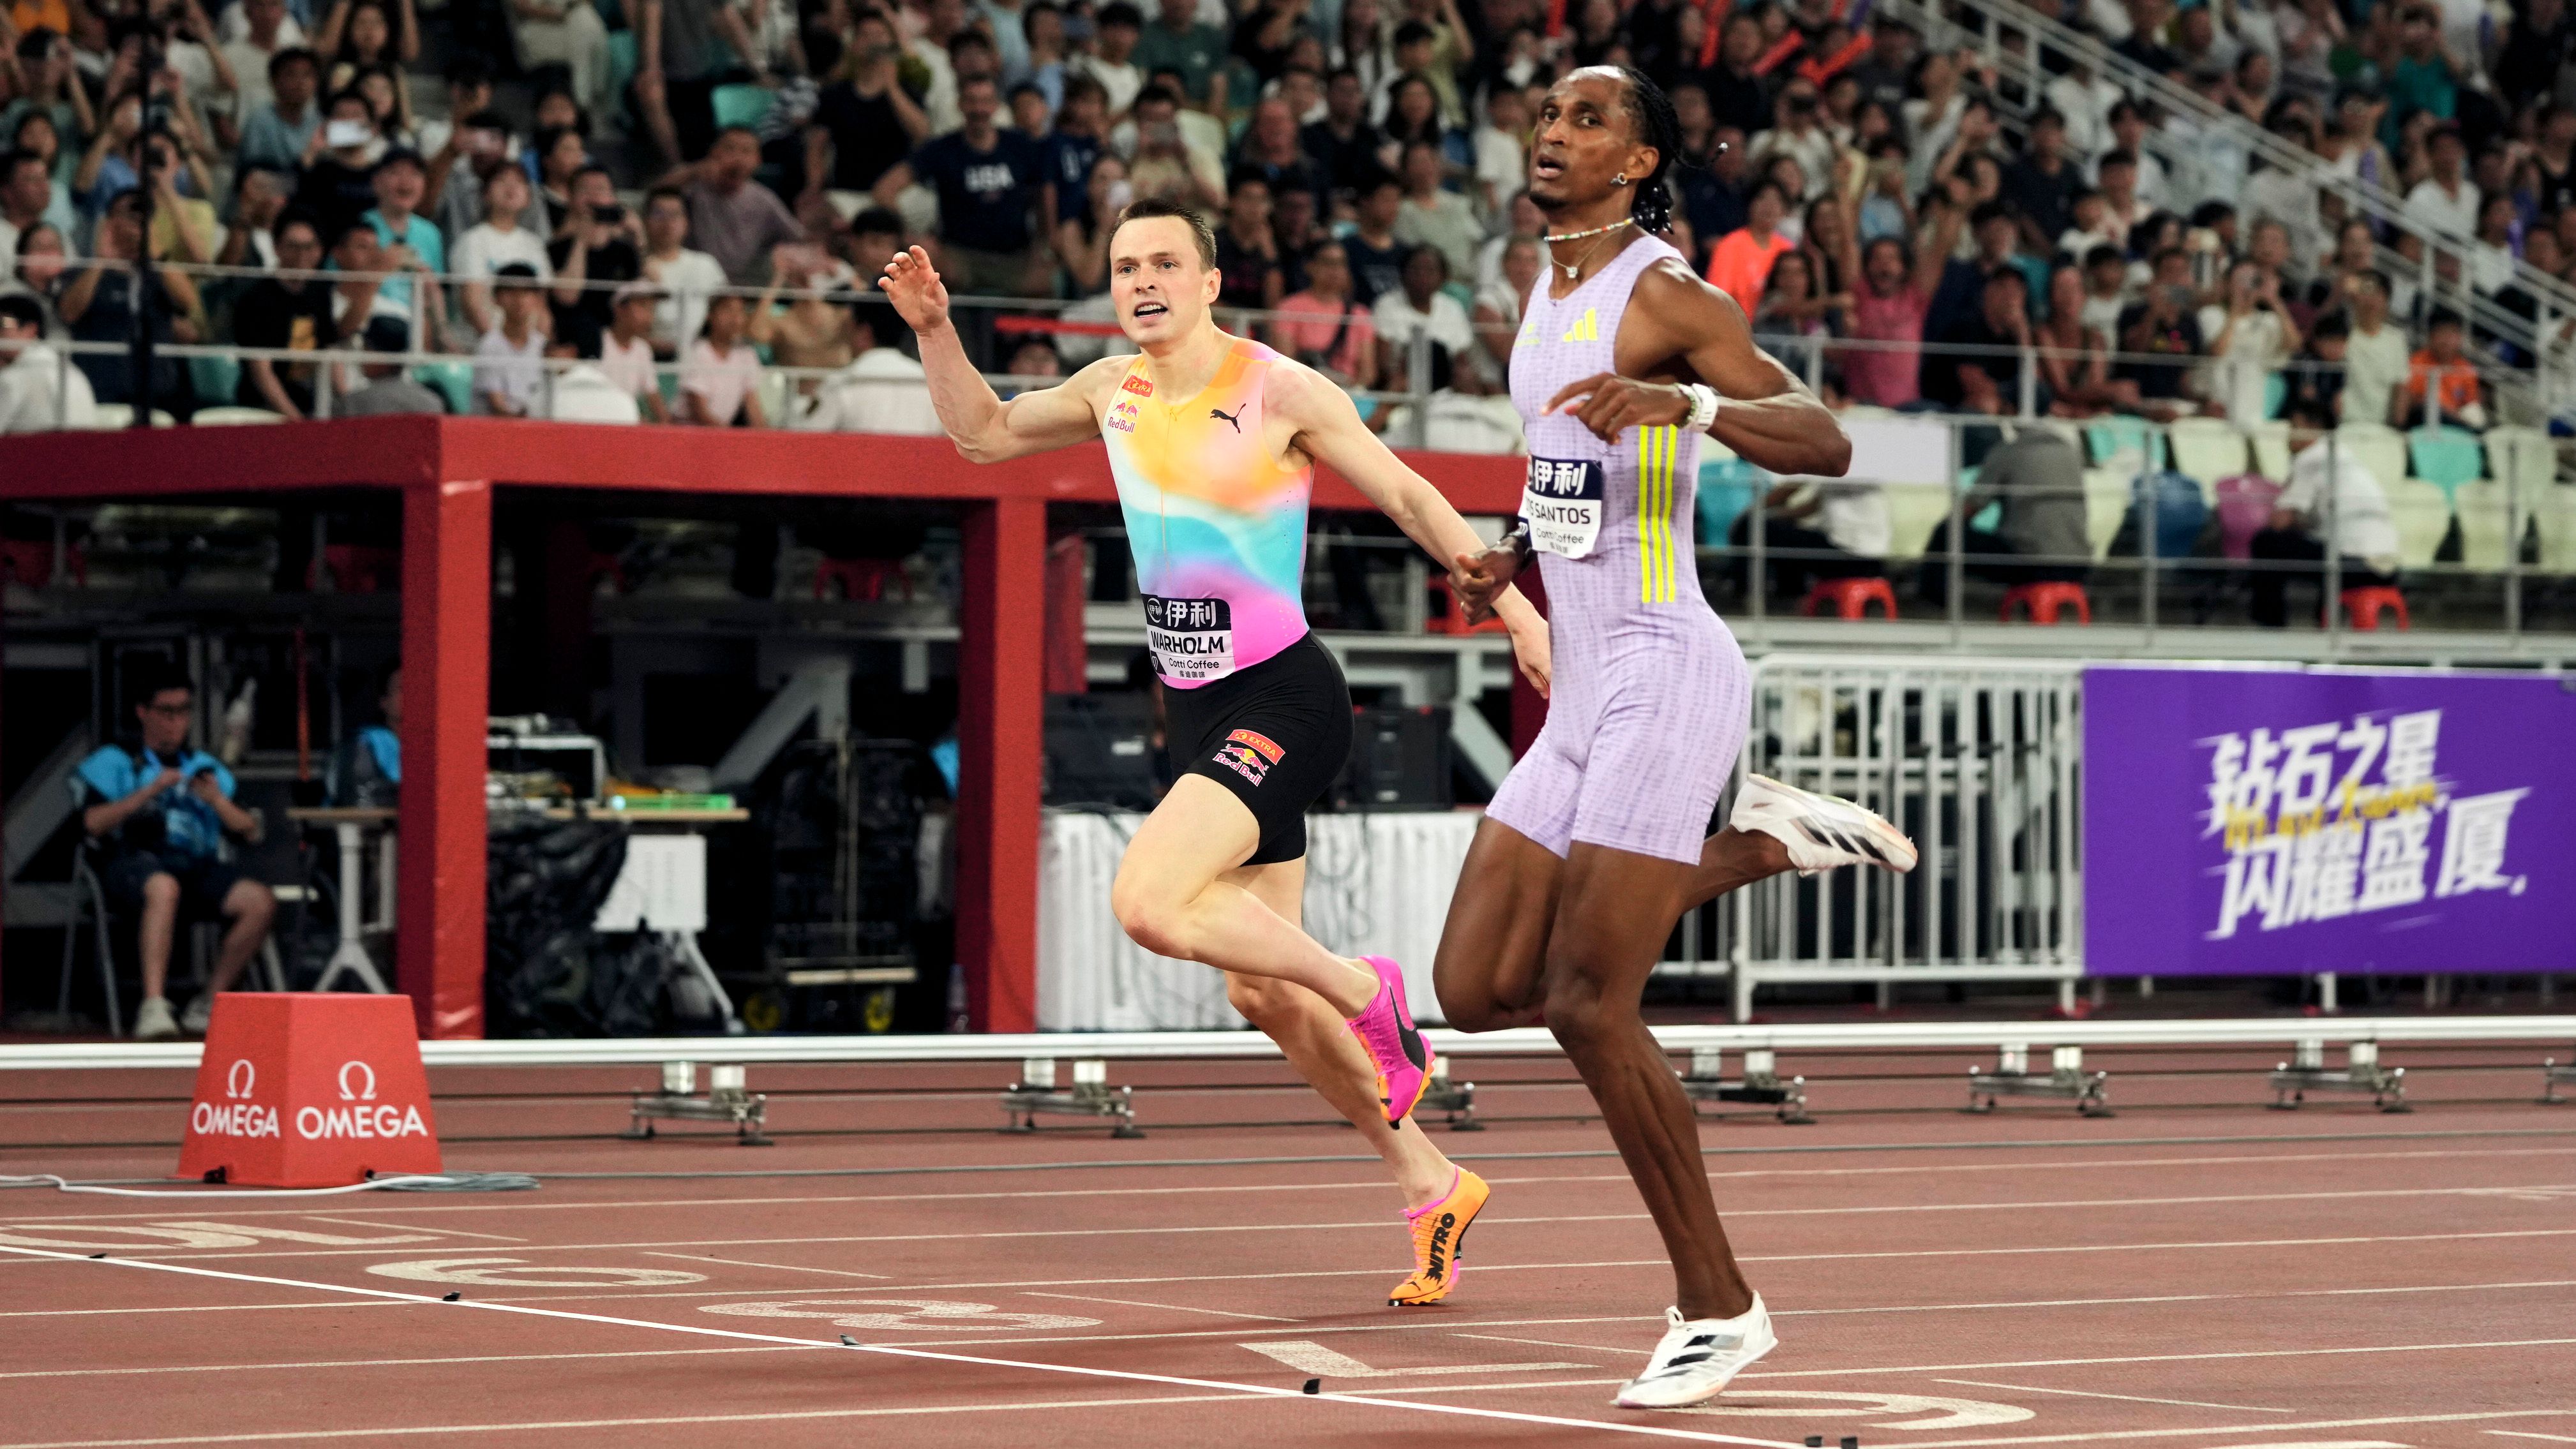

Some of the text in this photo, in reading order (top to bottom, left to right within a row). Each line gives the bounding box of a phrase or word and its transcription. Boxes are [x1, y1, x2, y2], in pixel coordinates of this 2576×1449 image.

[1107, 417, 1135, 433] Red Bull
[1534, 459, 1587, 496] 伊利
[1535, 503, 1591, 524] SANTOS
[1165, 600, 1217, 628] 伊利
[1150, 630, 1225, 655] WARHOLM
[1169, 658, 1220, 669] Cotti Coffee
[1248, 736, 1277, 757] EXTRA
[1213, 753, 1263, 787] Red Bull
[192, 1102, 280, 1138] OMEGA
[296, 1104, 428, 1140] OMEGA
[1423, 1212, 1456, 1286] NITRO
